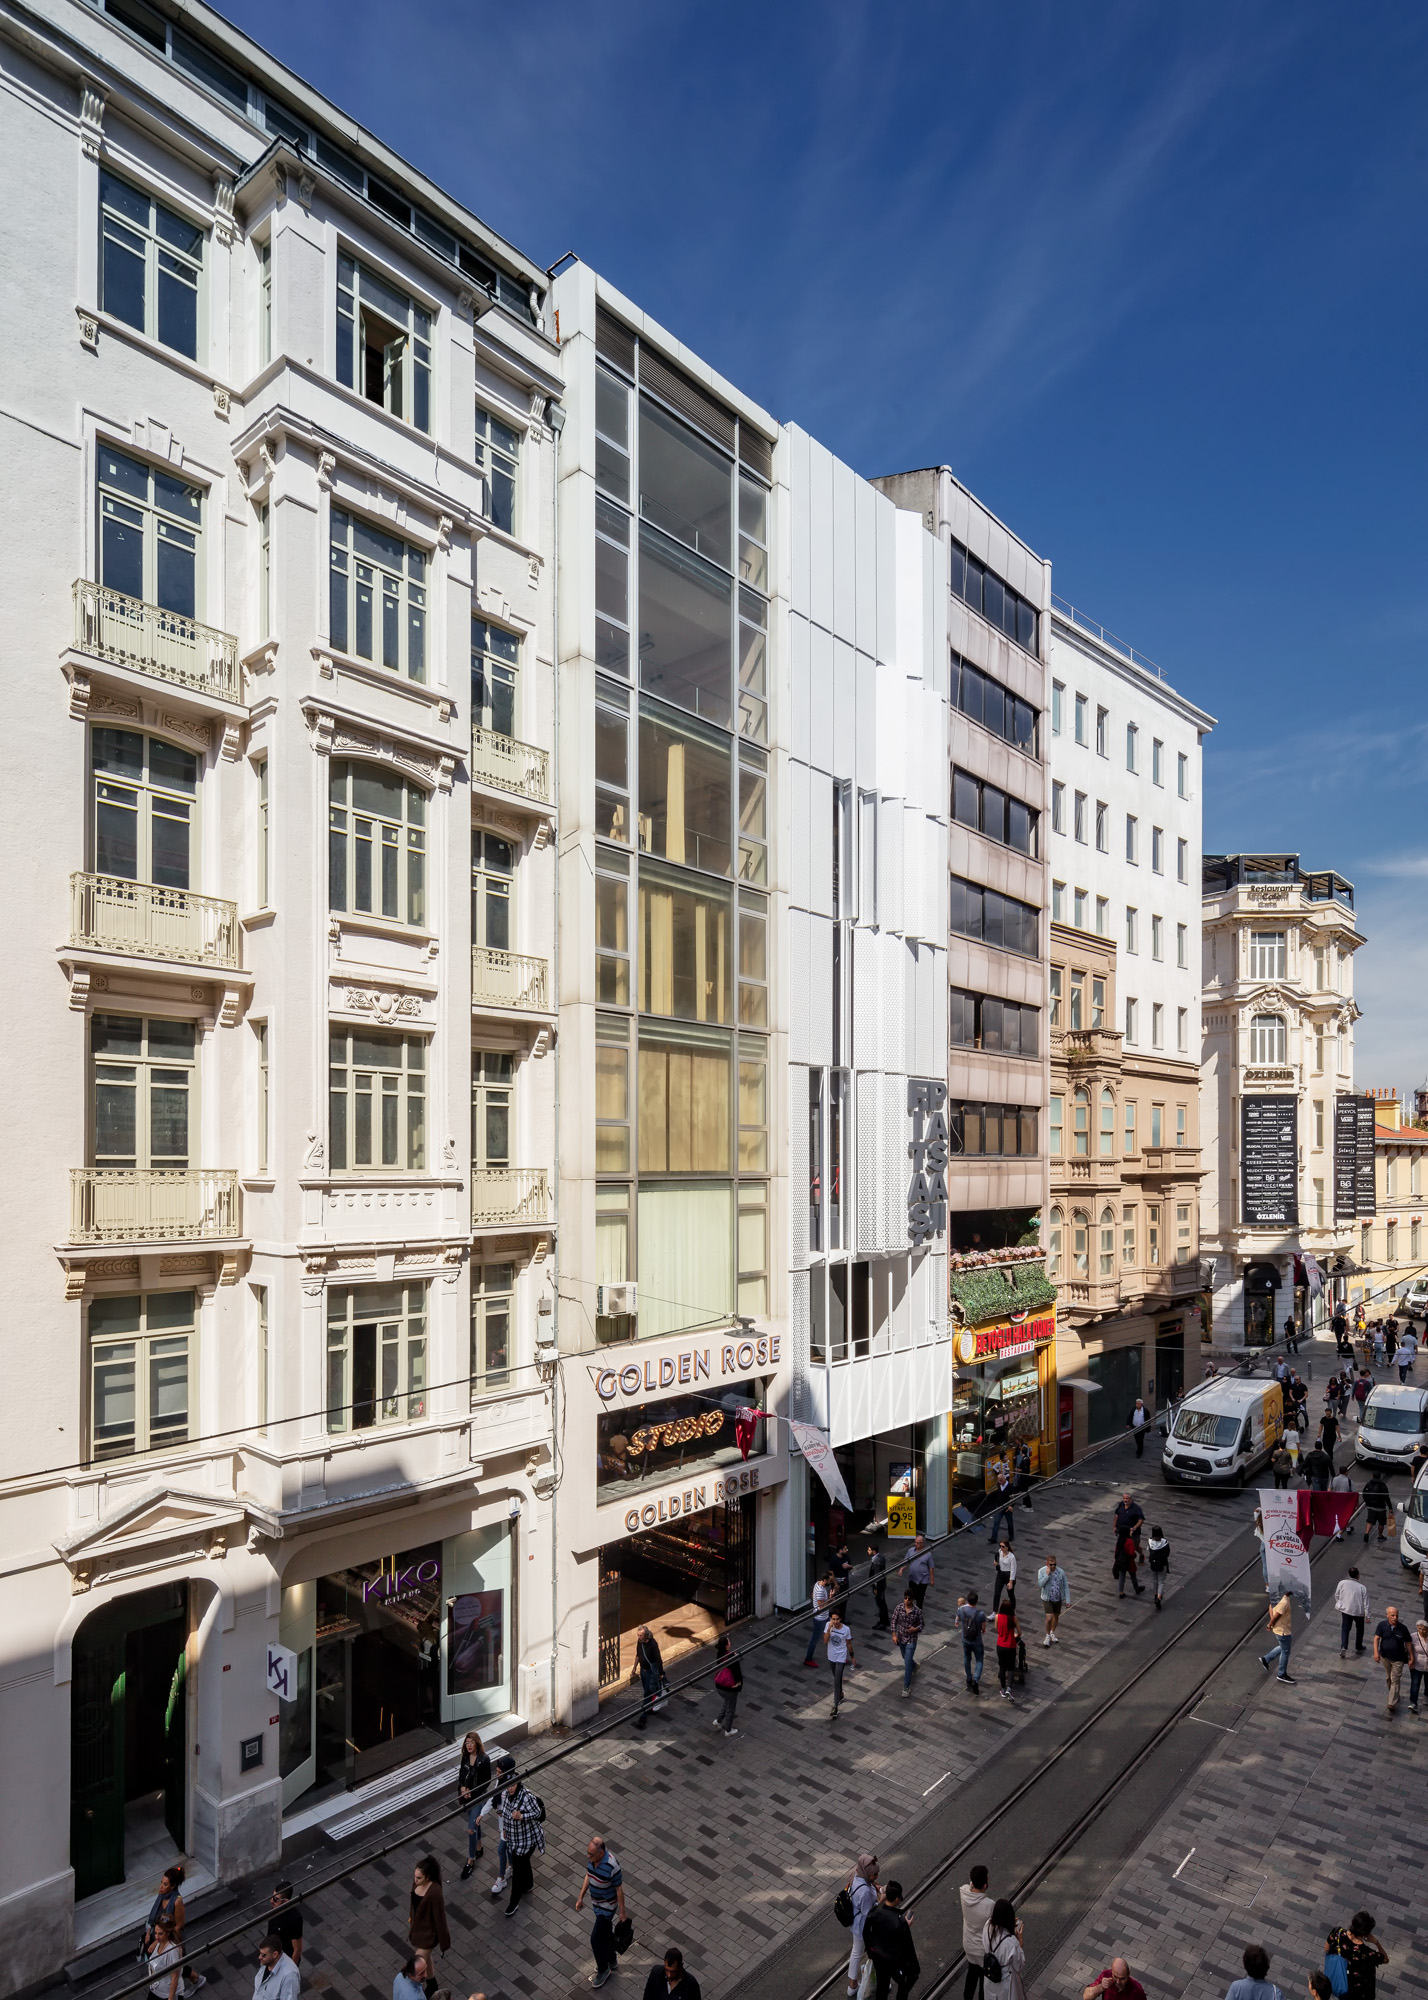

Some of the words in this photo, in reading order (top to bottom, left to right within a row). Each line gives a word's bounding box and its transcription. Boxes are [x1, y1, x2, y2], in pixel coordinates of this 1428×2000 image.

[1256, 1212, 1285, 1220] ÖZLENİR
[1013, 1322, 1032, 1344] HALK
[1000, 1342, 1034, 1358] RESTAURANT
[595, 1349, 711, 1398] GOLDEN
[721, 1335, 781, 1373] ROSE
[626, 1409, 725, 1456] STUDIO
[625, 1486, 706, 1530] GOLDEN
[714, 1468, 760, 1501] ROSE
[903, 1521, 914, 1530] TL
[362, 1559, 441, 1603] KIKO
[384, 1588, 421, 1606] MILANO
